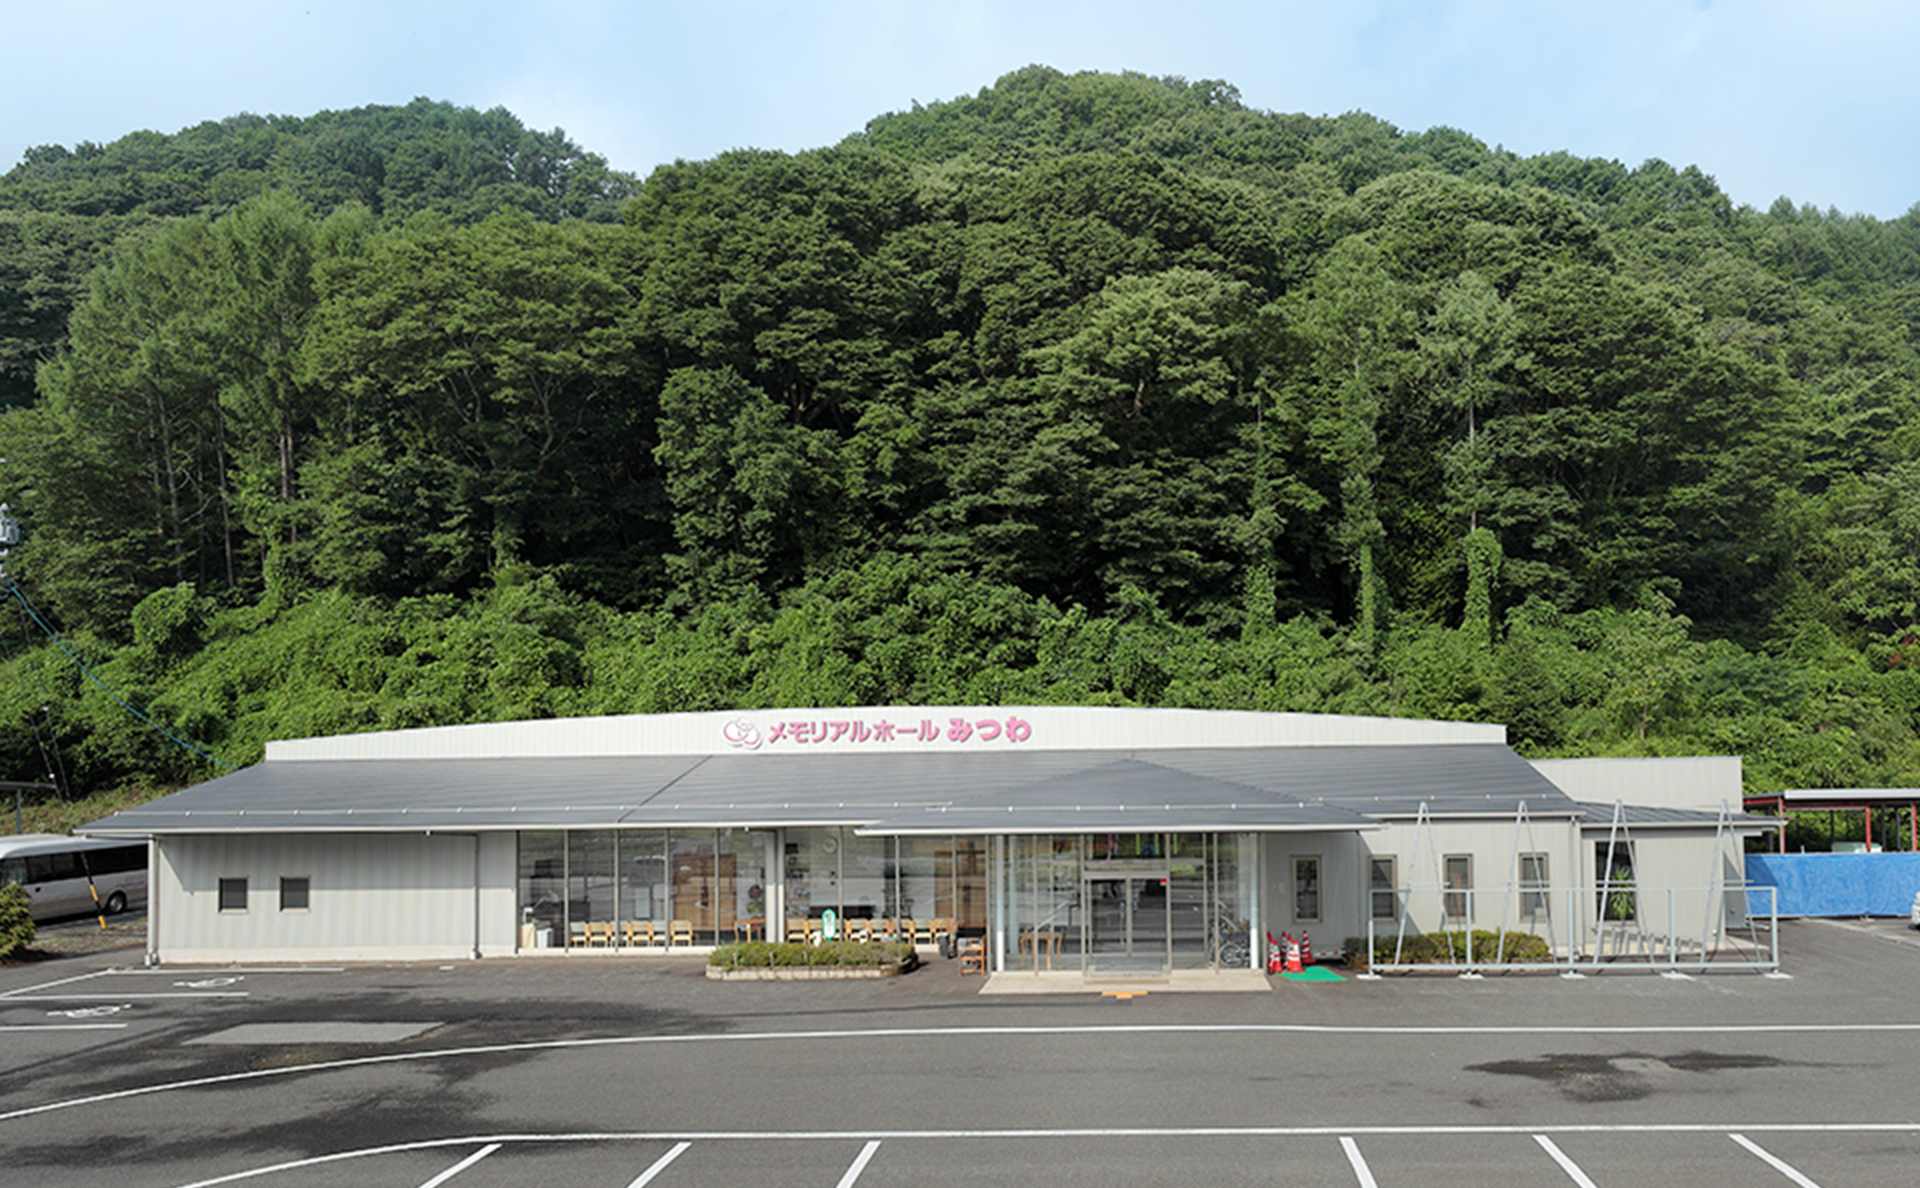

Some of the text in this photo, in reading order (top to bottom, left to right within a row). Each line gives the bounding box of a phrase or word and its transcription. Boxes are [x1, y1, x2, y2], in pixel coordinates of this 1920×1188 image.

[768, 716, 1031, 743] メモリアルホール みつわ
